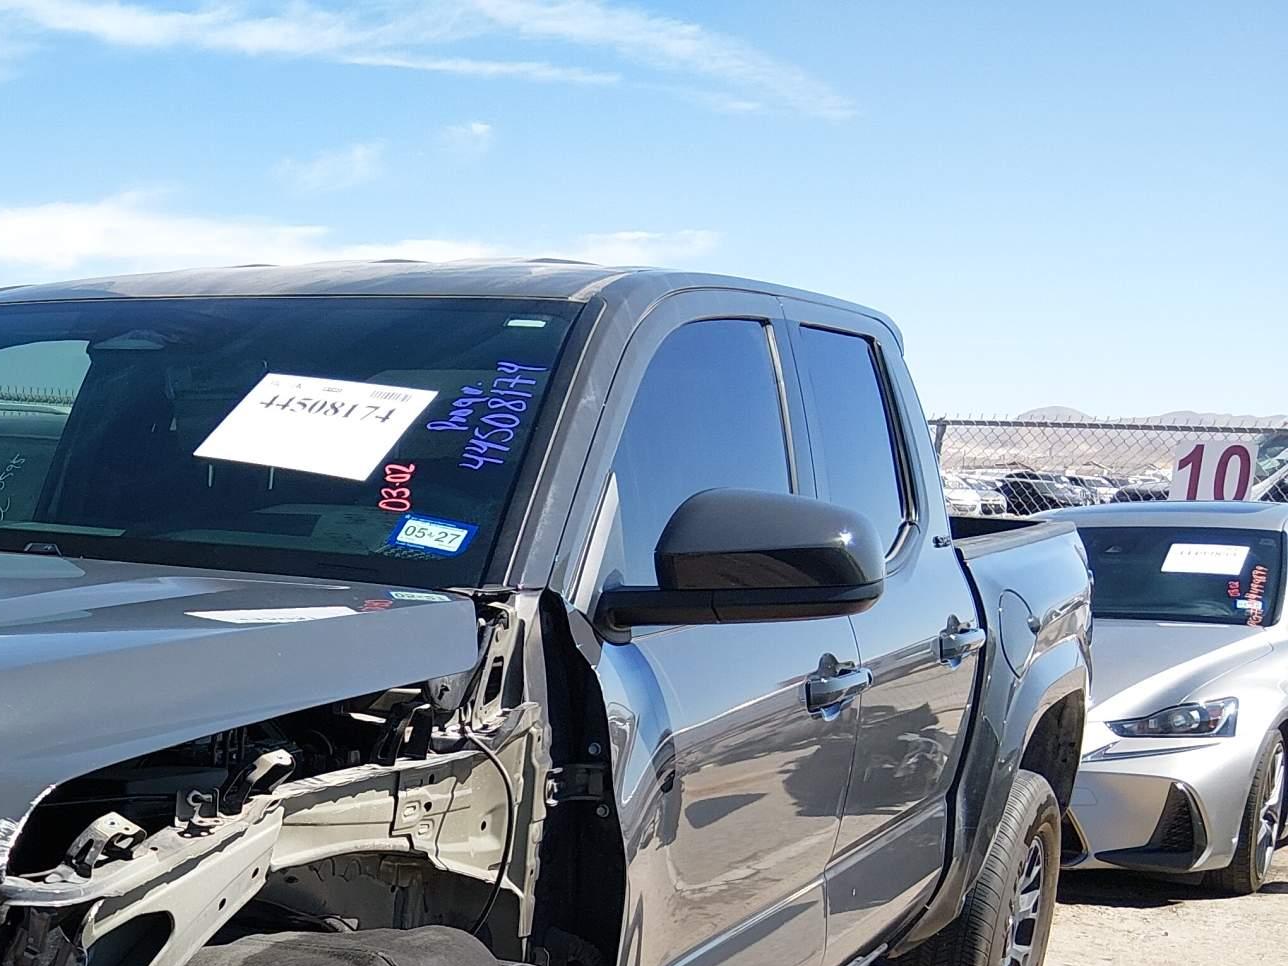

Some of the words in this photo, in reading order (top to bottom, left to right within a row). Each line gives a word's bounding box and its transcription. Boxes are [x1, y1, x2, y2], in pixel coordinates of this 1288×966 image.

[260, 394, 396, 423] 44508174
[459, 361, 547, 470] 44508174
[1178, 443, 1251, 501] 10
